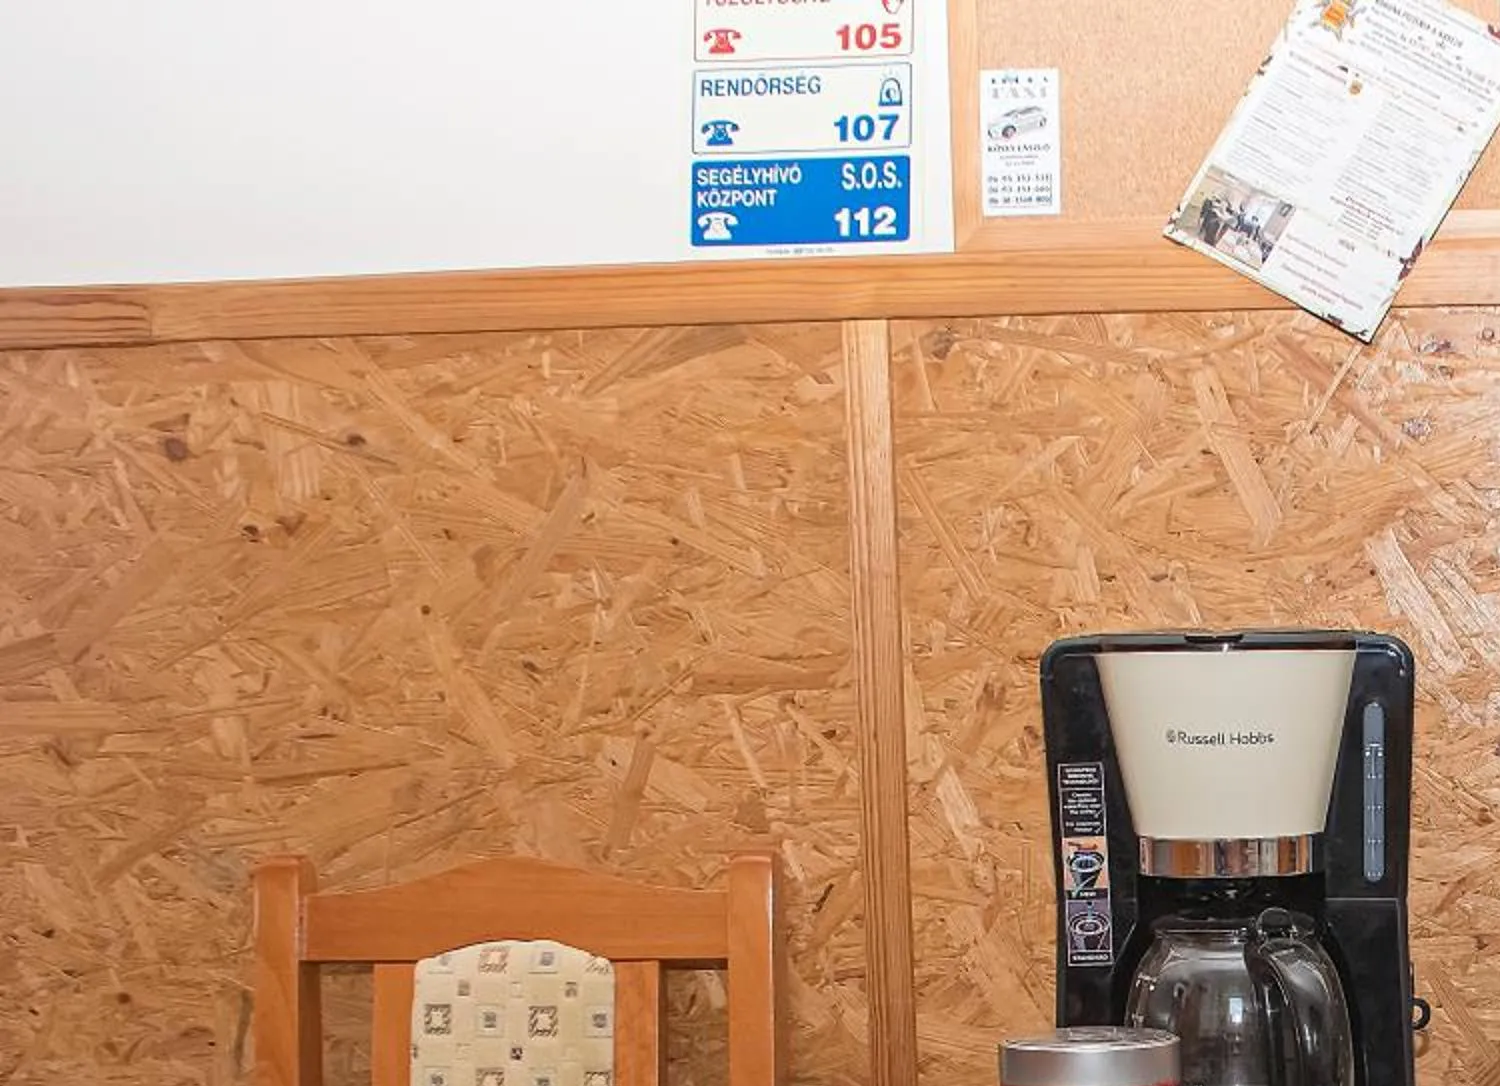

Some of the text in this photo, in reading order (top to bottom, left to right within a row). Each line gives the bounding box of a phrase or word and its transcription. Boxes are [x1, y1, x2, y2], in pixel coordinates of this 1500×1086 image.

[836, 23, 902, 50] 105
[833, 114, 900, 142] 107
[697, 161, 903, 191] SEGÉLYHÍVÓ S.O.S.
[697, 188, 777, 208] KÖZPONT
[834, 206, 897, 237] 112
[1177, 731, 1275, 745] Russell Hobbs
